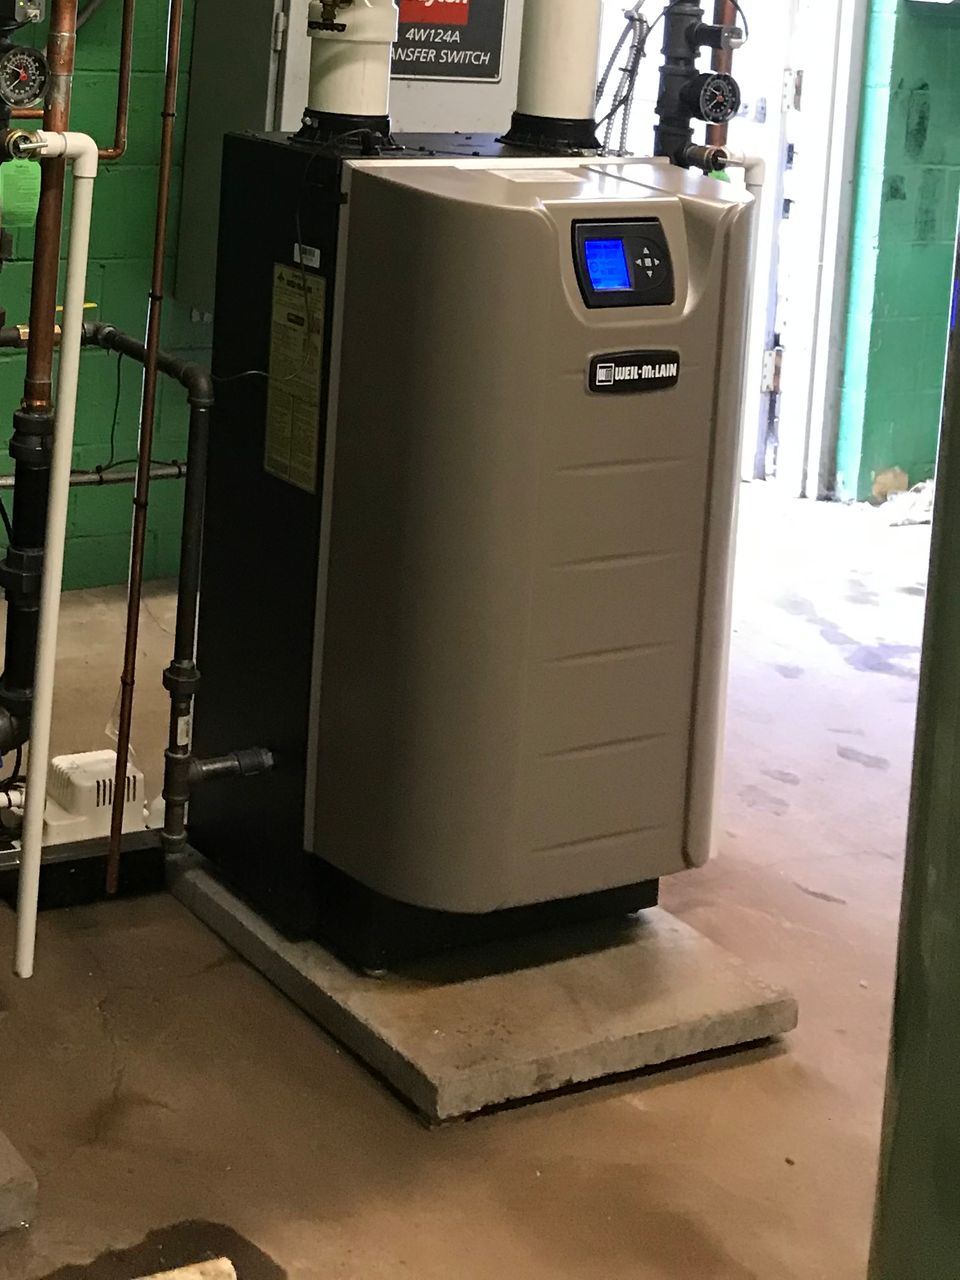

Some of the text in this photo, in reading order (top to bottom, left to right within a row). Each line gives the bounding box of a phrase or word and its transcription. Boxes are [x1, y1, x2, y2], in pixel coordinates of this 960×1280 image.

[405, 28, 461, 43] 4W124A
[391, 48, 490, 65] ANSFER SWITCH
